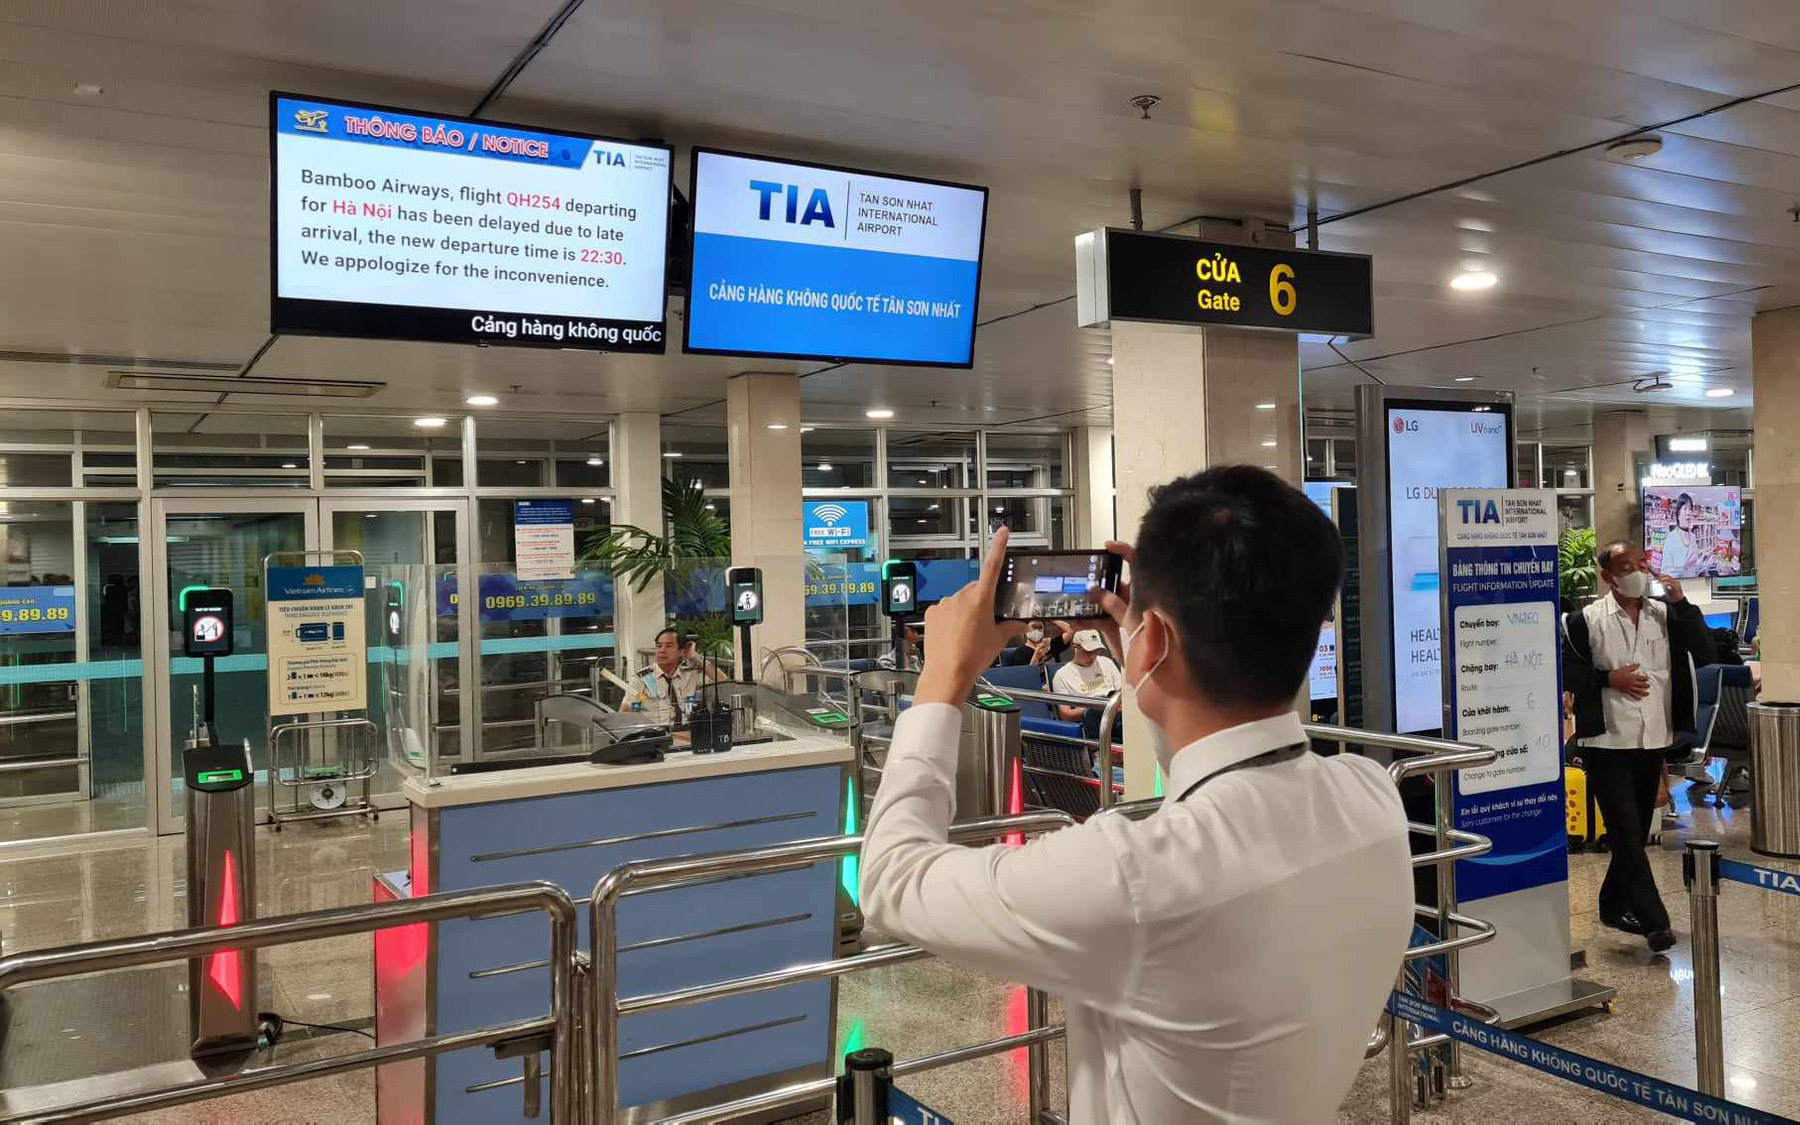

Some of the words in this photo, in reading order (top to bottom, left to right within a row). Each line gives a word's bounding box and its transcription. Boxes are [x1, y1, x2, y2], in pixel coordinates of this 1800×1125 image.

[344, 115, 417, 142] THÔNG
[422, 121, 465, 147] BÁO
[467, 132, 479, 151] /
[482, 134, 549, 159] NOTICE
[593, 150, 626, 167] TIA
[301, 169, 376, 190] Bamboo
[382, 178, 454, 202] Airways,
[460, 186, 502, 206] flight
[507, 191, 561, 210] QH254
[565, 198, 637, 222] departing
[749, 179, 836, 229] TIA
[859, 192, 880, 205] TAN
[882, 196, 904, 208] SON
[906, 199, 934, 211] NHAT
[301, 195, 327, 212] for
[333, 200, 357, 216] Hà
[363, 202, 392, 221] Nội
[397, 205, 428, 222] has
[433, 209, 473, 227] been
[478, 214, 540, 235] delayed
[545, 220, 573, 237] due
[577, 225, 592, 239] to
[596, 225, 624, 242] late
[857, 207, 938, 226] INTERNATIONAL
[857, 221, 903, 236] AIRPORT
[301, 225, 363, 245] arrival,
[368, 229, 396, 245] the
[401, 235, 435, 249] new
[440, 235, 520, 256] departure
[525, 243, 559, 260] time
[563, 246, 576, 261] is
[580, 249, 627, 266] 22:30.
[301, 249, 329, 266] We
[334, 255, 430, 275] appologize
[435, 260, 459, 276] for
[463, 263, 489, 279] the
[494, 265, 609, 288] inconvenience.
[1196, 252, 1242, 284] CỬA
[709, 278, 746, 303] CẢNG
[748, 283, 783, 305] HÀNG
[786, 287, 829, 309] KHÔNG
[831, 290, 864, 313] QUỐC
[866, 292, 882, 313] TẾ
[882, 295, 905, 314] TÂN
[931, 299, 962, 319] NHẤT
[1269, 263, 1297, 317] 6
[1197, 289, 1241, 312] Gate
[471, 314, 517, 338] Cảng
[521, 318, 564, 340] hàng
[568, 321, 619, 343] không
[622, 325, 662, 343] quốc
[1405, 420, 1419, 432] LG
[1406, 486, 1420, 500] LG
[1456, 499, 1500, 525] TIA
[1505, 499, 1516, 507] TAN
[1529, 499, 1542, 507] NHAT
[1505, 507, 1547, 516] INTERNATIONAL
[1505, 516, 1528, 524] AIRPORT
[1452, 559, 1473, 577] BẢNG
[1475, 560, 1499, 576] THÔNG
[1500, 562, 1512, 575] TIN
[1541, 560, 1554, 574] BAY
[1453, 582, 1478, 593] FLIGHT
[1478, 580, 1528, 592] INFORMATION
[1528, 578, 1554, 589] UPDATE
[485, 592, 596, 609] 0969.39.89.89
[0, 607, 68, 622] 9.89.89
[1460, 618, 1486, 630] Chuyến
[1485, 619, 1500, 628] bay:
[1461, 664, 1483, 675] Chặng
[1484, 663, 1499, 673] bay:
[1492, 704, 1511, 714] hành:
[1462, 727, 1486, 736] Boarding
[1486, 725, 1499, 735] gate
[1463, 770, 1486, 781] Change
[1486, 769, 1492, 777] to
[1492, 768, 1506, 778] gate
[1460, 808, 1470, 816] Xin
[1524, 798, 1537, 807] thay
[1753, 868, 1800, 892] TIA
[1452, 1019, 1487, 1044] CẢNG
[1490, 1034, 1529, 1058] HÀNG
[1532, 1048, 1581, 1076] KHÔNG
[1585, 1066, 1628, 1092] QUỐC
[1632, 1080, 1652, 1100] TẾ
[1656, 1088, 1688, 1112] TÂN
[1693, 1101, 1730, 1125] SƠN
